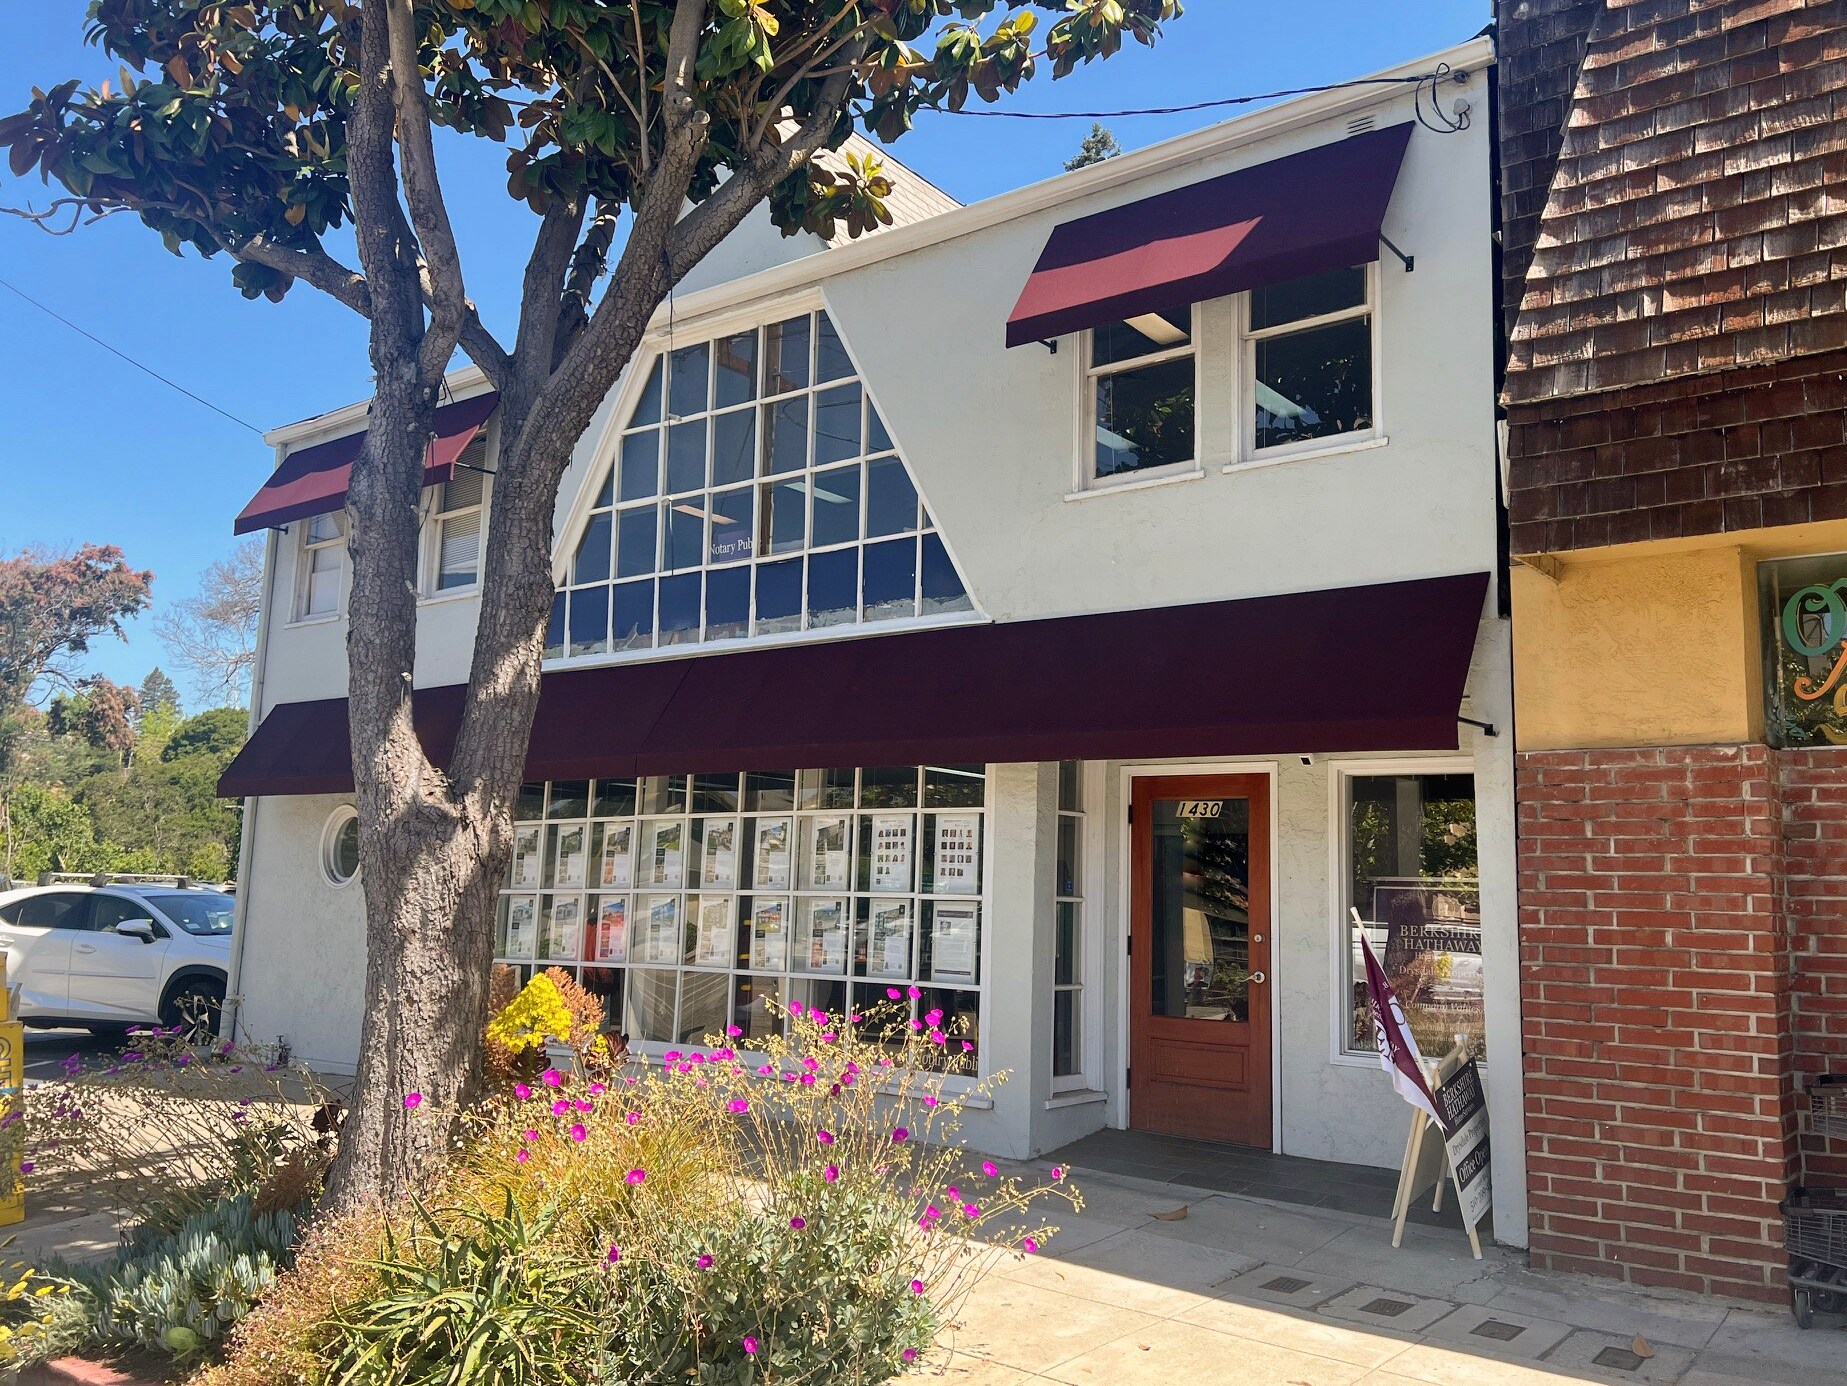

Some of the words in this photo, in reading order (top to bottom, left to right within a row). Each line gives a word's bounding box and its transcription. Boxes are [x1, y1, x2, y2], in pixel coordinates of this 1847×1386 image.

[711, 542, 736, 555] Notary
[737, 537, 752, 551] Pub
[1179, 802, 1220, 817] 1430
[1400, 924, 1480, 939] BERKSHIR
[1404, 938, 1481, 952] HATHAWAY
[922, 1051, 950, 1070] otary
[953, 1054, 979, 1071] Publi
[1443, 1069, 1475, 1108] BERKSHIRE
[1446, 1084, 1476, 1121] HATHAWAY
[1459, 1158, 1477, 1183] Office
